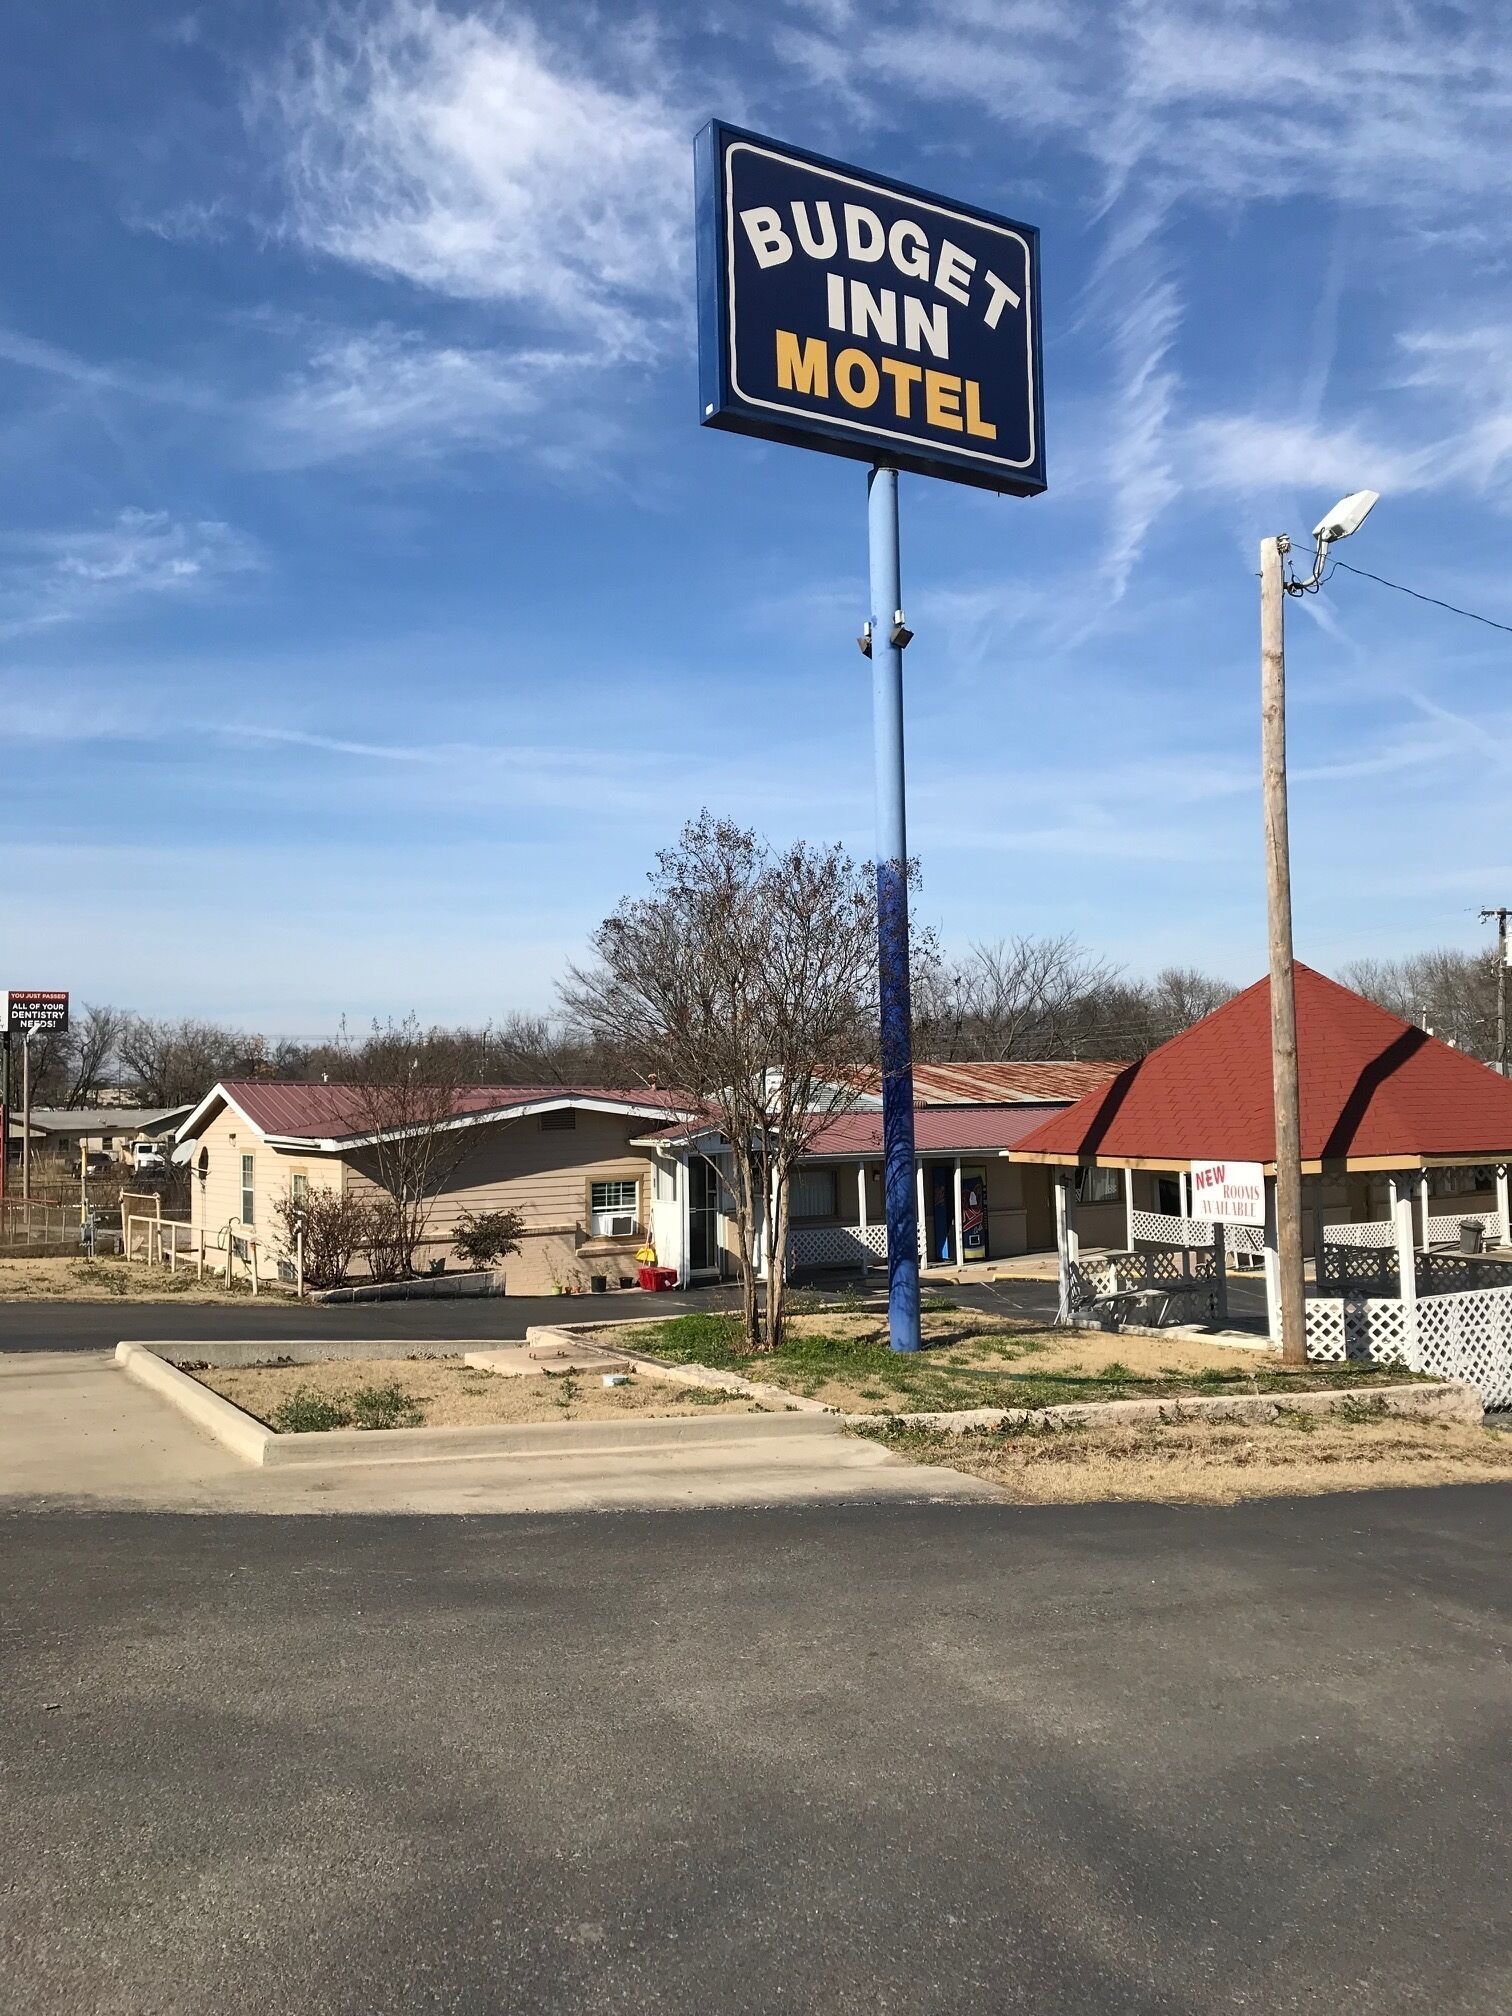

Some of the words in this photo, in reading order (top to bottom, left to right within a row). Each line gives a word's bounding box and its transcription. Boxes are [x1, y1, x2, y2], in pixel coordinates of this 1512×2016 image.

[739, 201, 1020, 330] BUDGET
[827, 272, 949, 360] INN
[775, 329, 997, 440] MOTEL
[1196, 1165, 1225, 1190] NEW
[1223, 1185, 1259, 1200] ROOMS
[1201, 1200, 1256, 1217] AVAILABLE
